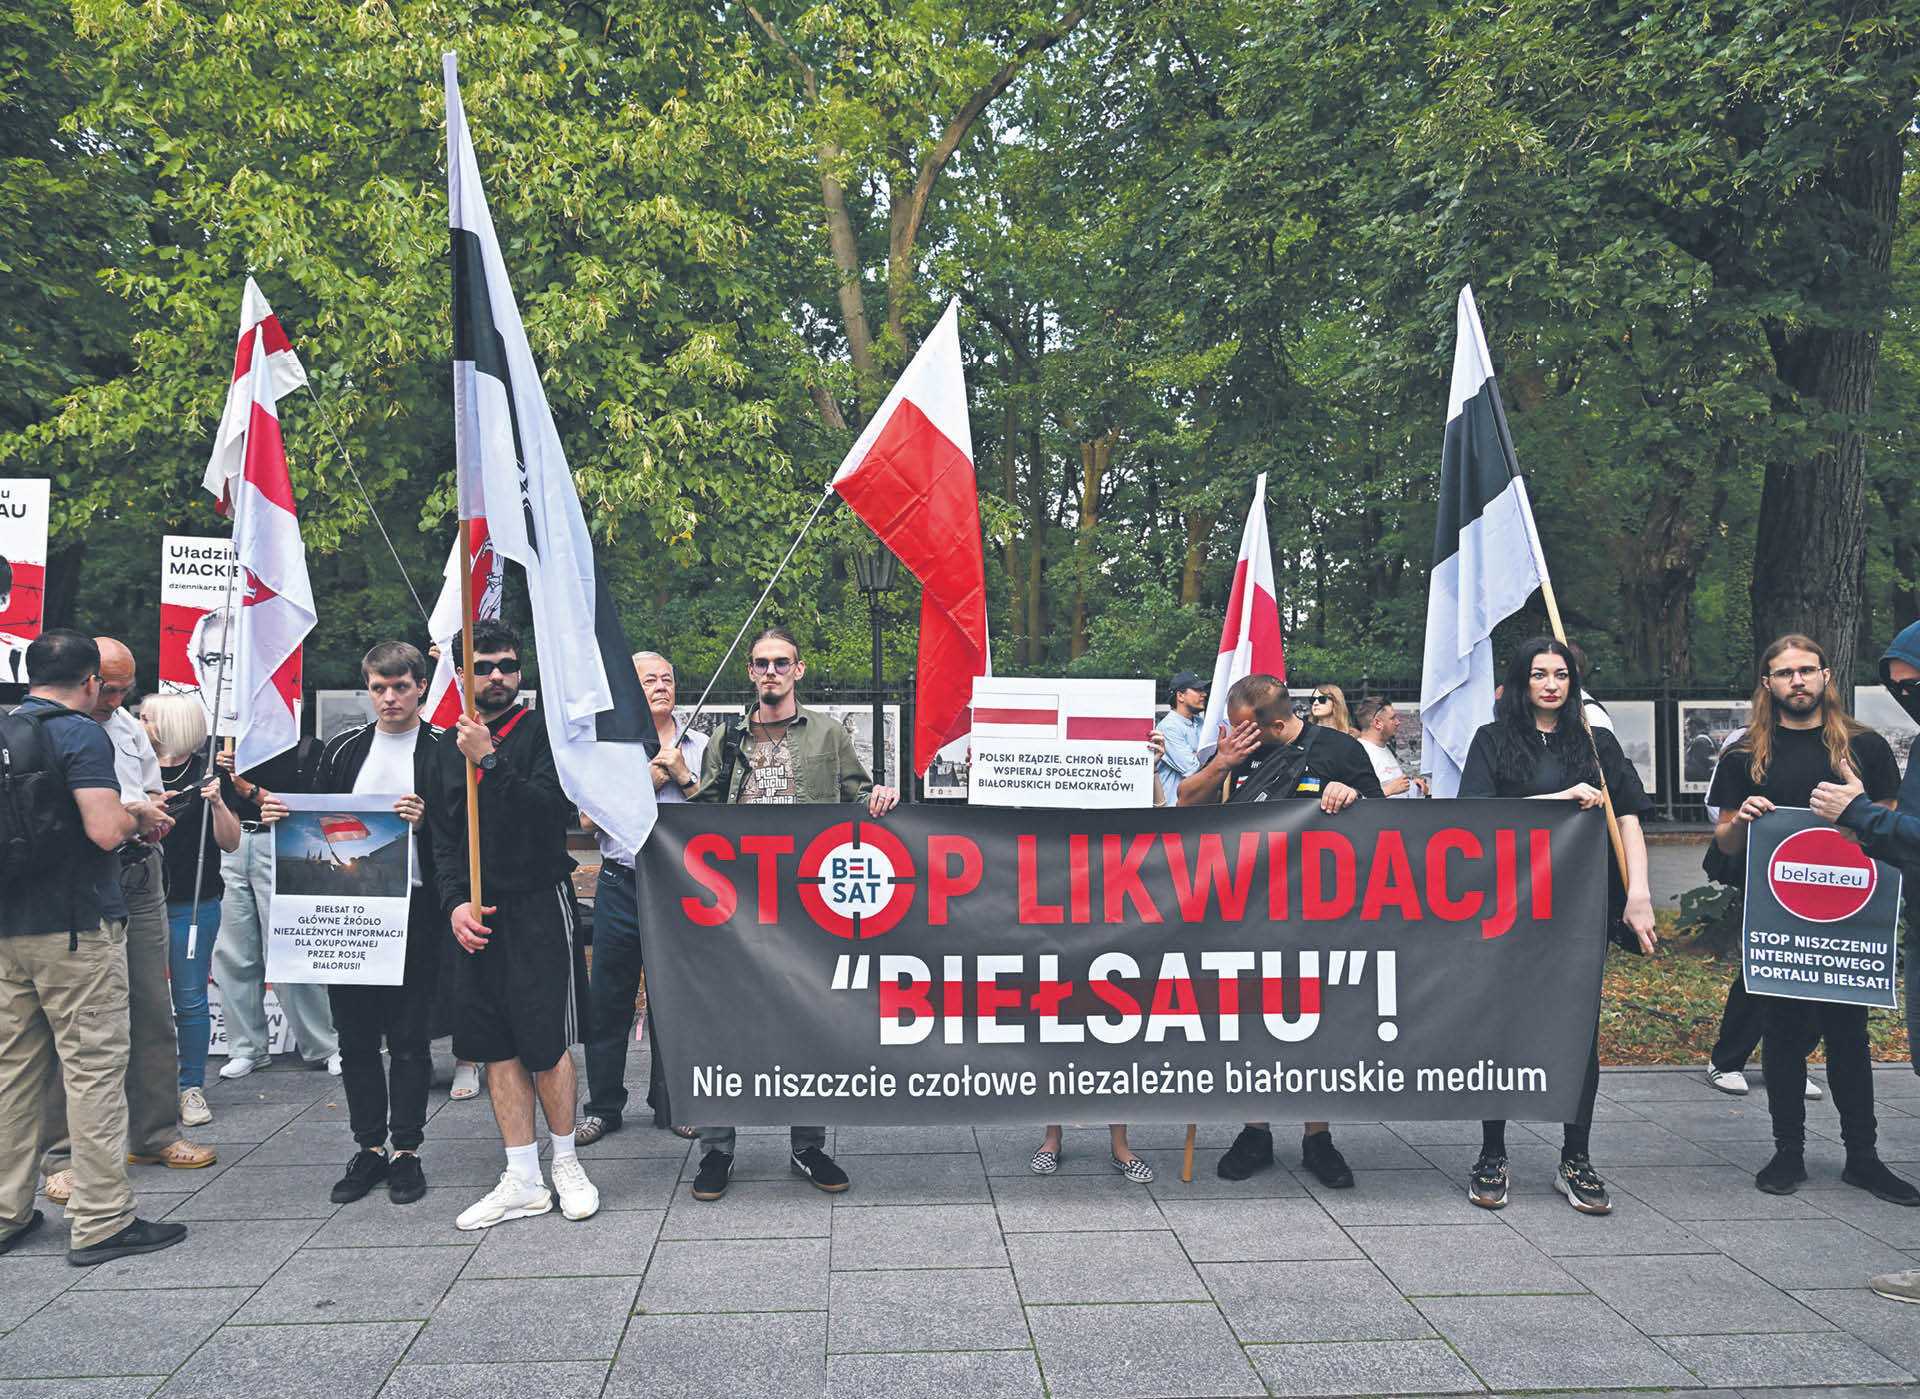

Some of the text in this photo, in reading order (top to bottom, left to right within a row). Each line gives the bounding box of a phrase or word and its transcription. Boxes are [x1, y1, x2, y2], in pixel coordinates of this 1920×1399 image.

[168, 583, 217, 592] dziennikarz
[979, 753, 1015, 762] POLSKI
[1065, 754, 1103, 764] CHROŃ
[1107, 756, 1149, 766] BIEŁSAT!
[993, 766, 1122, 778] WSPIERAJ SPOŁECZNOŚĆ
[978, 779, 1134, 792] BIAŁORUSKICH DEMOKRATÓW!
[832, 858, 881, 879] BEL
[681, 821, 1553, 940] STOP LIKWIDACJI
[1781, 865, 1862, 886] belsat.eu
[832, 882, 881, 903] SAT
[315, 905, 365, 914] BIEŁSAT TO
[298, 914, 341, 925] GŁÓWNE
[346, 929, 404, 938] INFORMACJI
[295, 938, 379, 948] DLA OKUPOWANEJ
[1750, 931, 1888, 955] STOP NISZCZENIU
[307, 950, 366, 960] PRZEZ ROSJĘ
[1750, 948, 1885, 972] INTERNETOWEGO
[312, 961, 361, 970] BIAŁORUSI!
[1750, 965, 1890, 990] PORTALU BIEŁSAT!
[693, 1060, 1548, 1097] Nie niszczcie czołowe niezależne białoruskie medium
